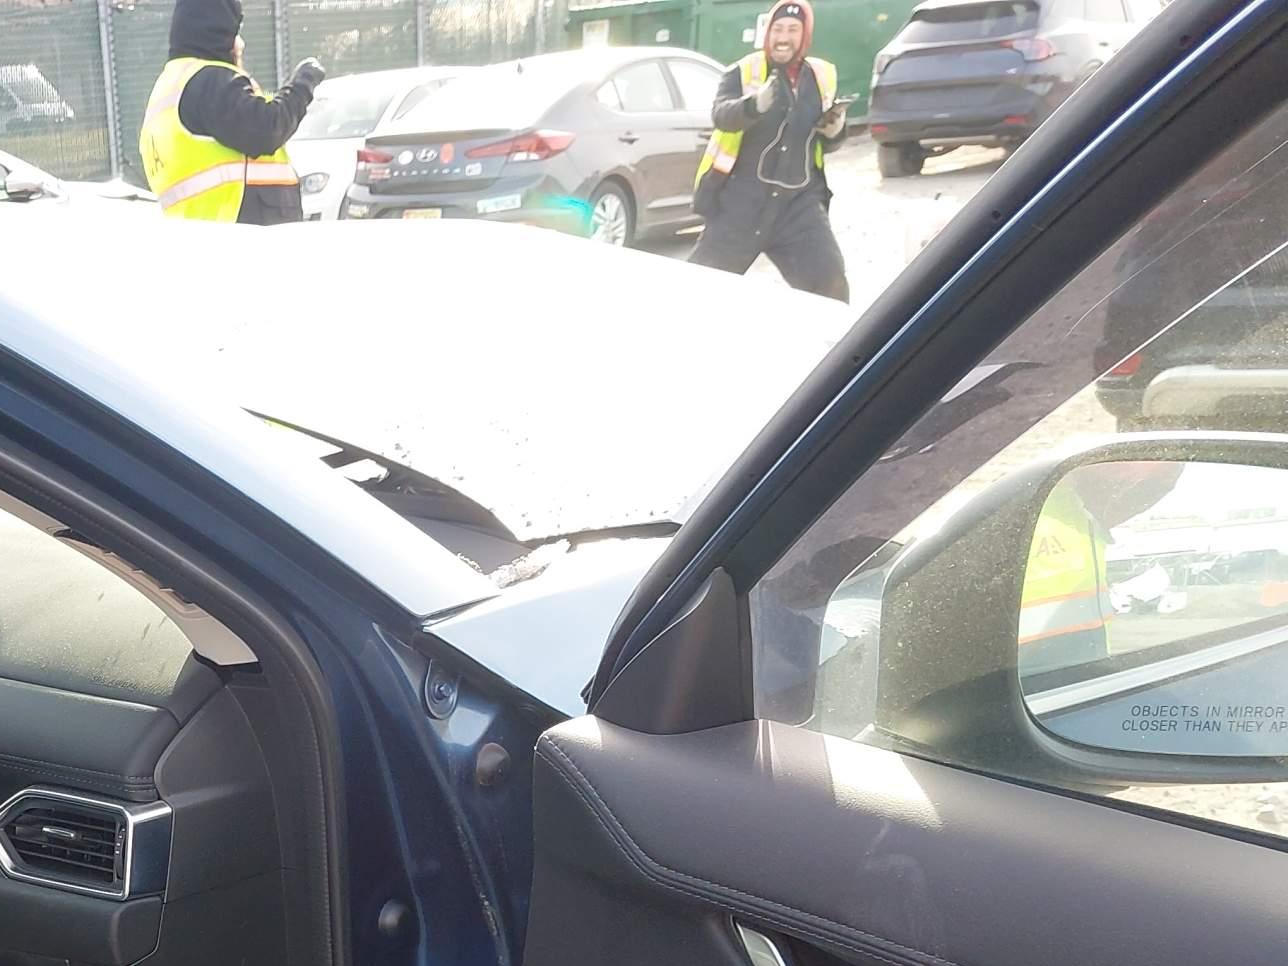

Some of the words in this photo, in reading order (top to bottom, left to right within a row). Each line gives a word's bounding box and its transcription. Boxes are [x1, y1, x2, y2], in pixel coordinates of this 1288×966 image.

[1131, 705, 1199, 717] OBJECTS
[1206, 706, 1221, 717] IN
[1226, 706, 1285, 718] MIRROR
[1122, 720, 1177, 731] CLOSER
[1184, 720, 1222, 732] THAN
[1227, 721, 1263, 732] THEY
